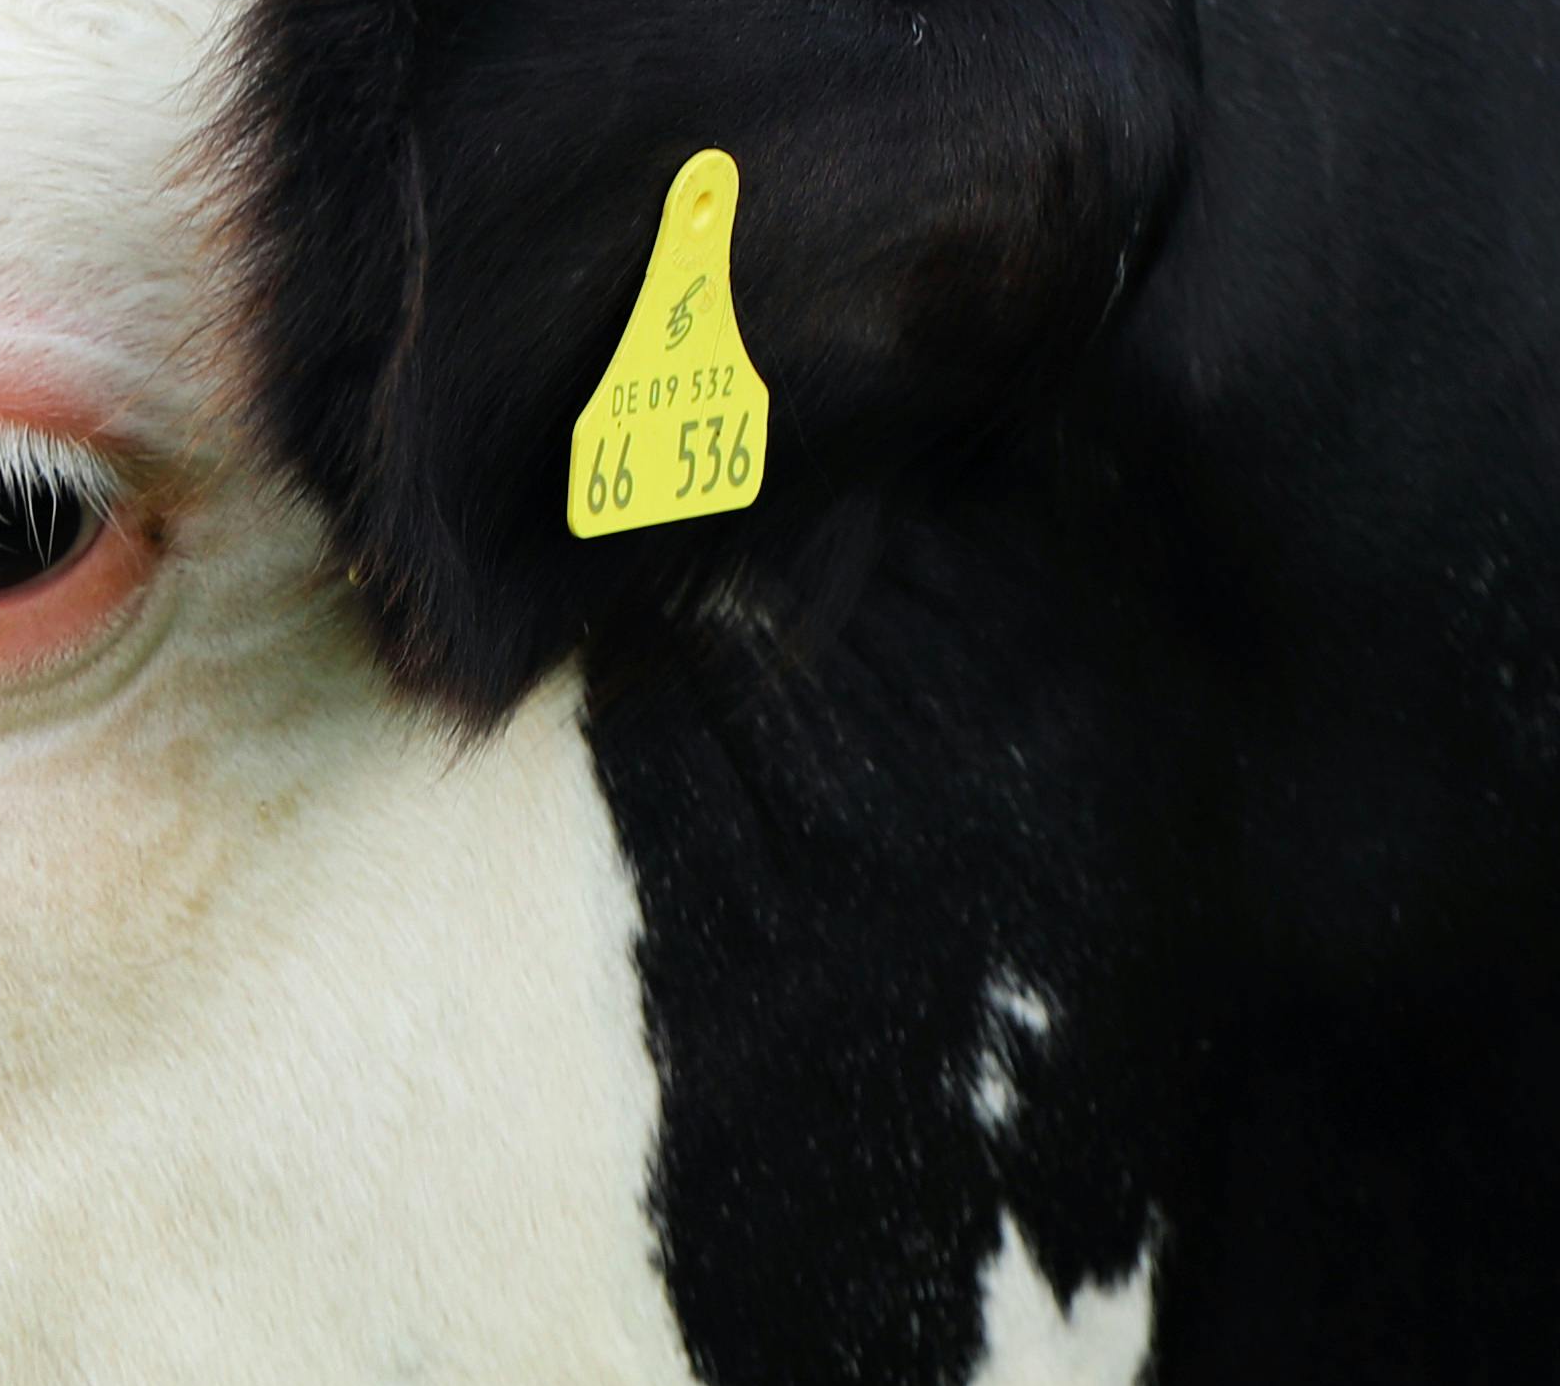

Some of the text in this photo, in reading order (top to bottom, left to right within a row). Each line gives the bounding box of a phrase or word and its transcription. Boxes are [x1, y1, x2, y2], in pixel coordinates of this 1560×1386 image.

[612, 365, 734, 417] DE 09 532
[587, 410, 750, 514] 66 536
